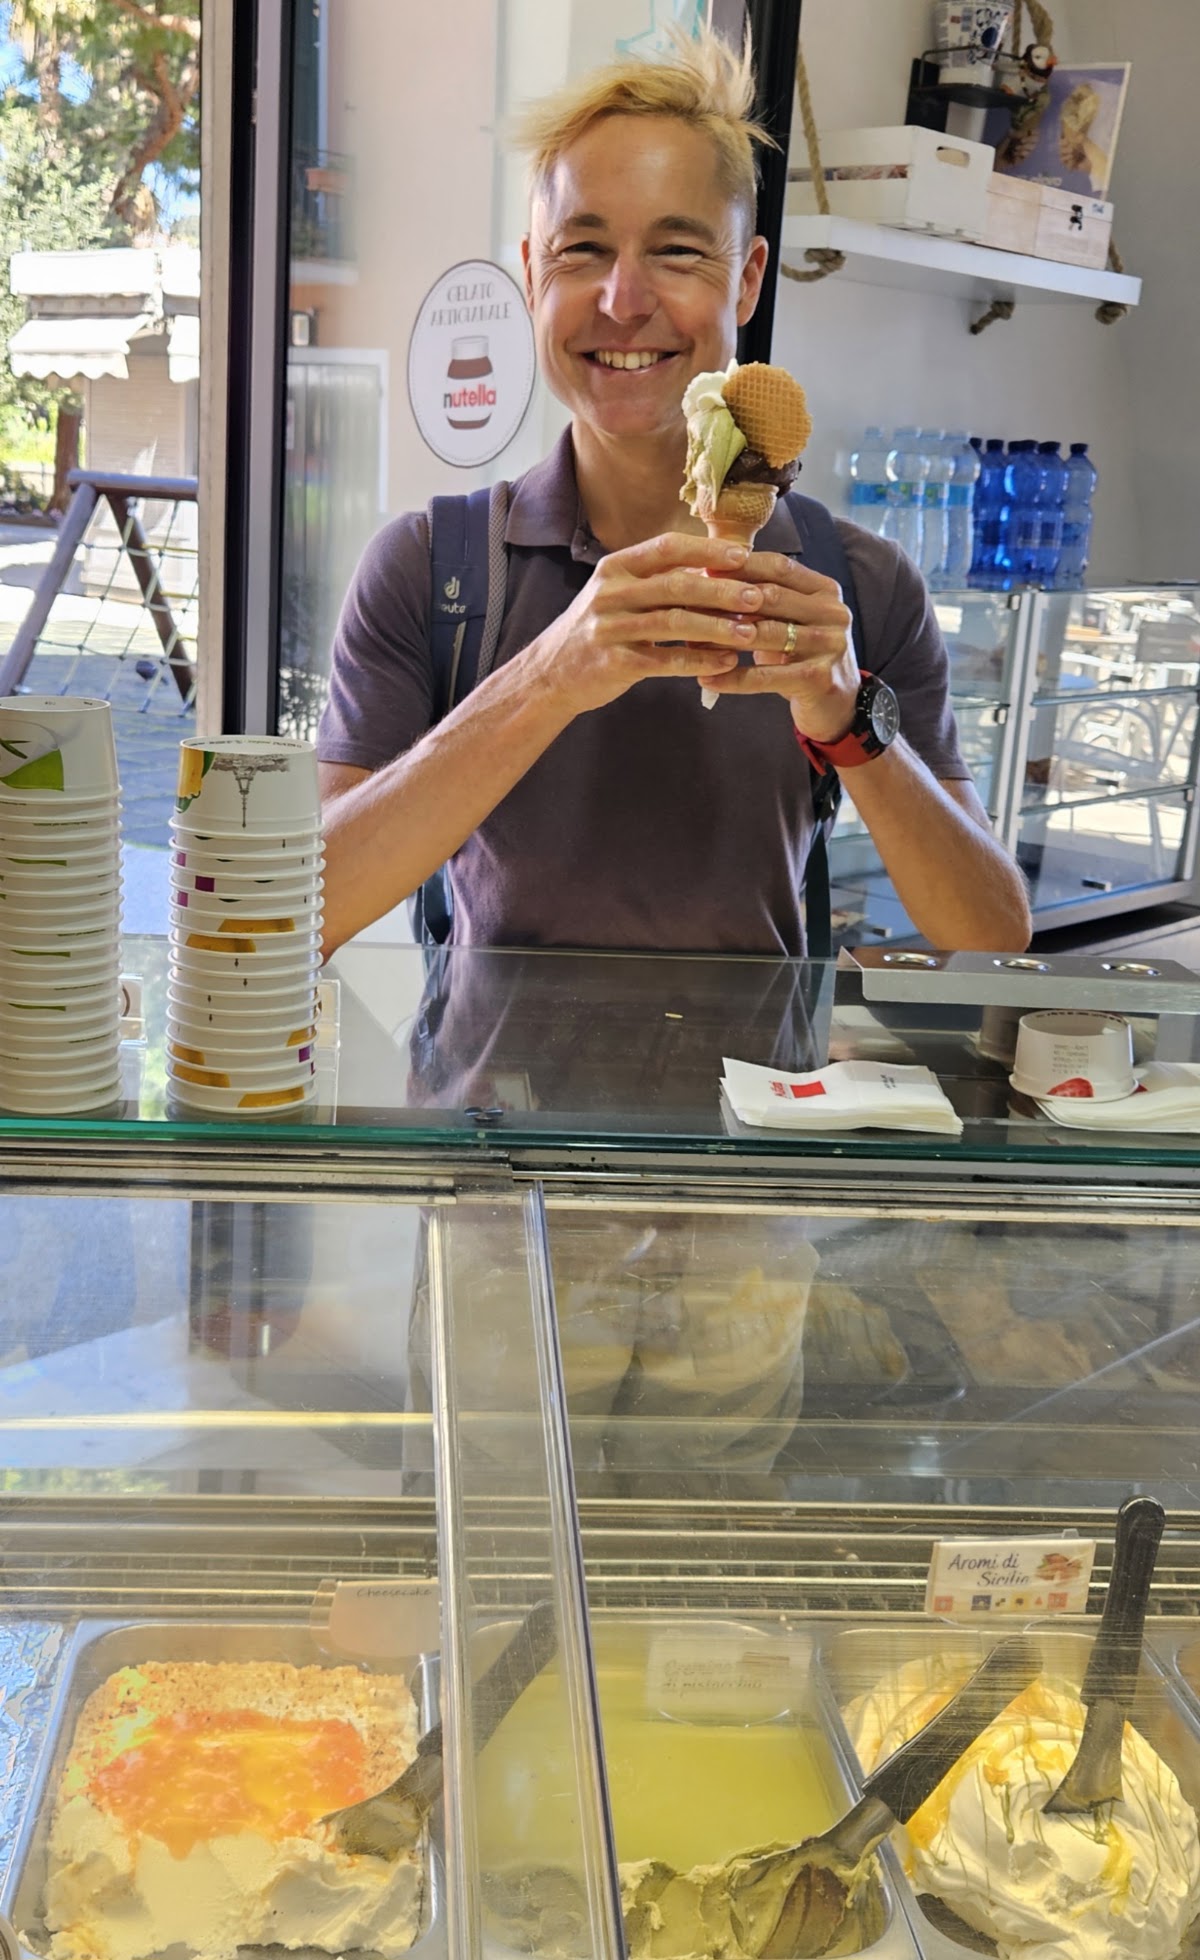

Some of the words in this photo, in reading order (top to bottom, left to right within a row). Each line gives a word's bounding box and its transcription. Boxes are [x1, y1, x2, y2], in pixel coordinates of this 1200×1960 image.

[447, 281, 494, 303] GELATO
[443, 384, 497, 408] nutella
[947, 1553, 999, 1570] Aromi
[1002, 1552, 1019, 1569] di
